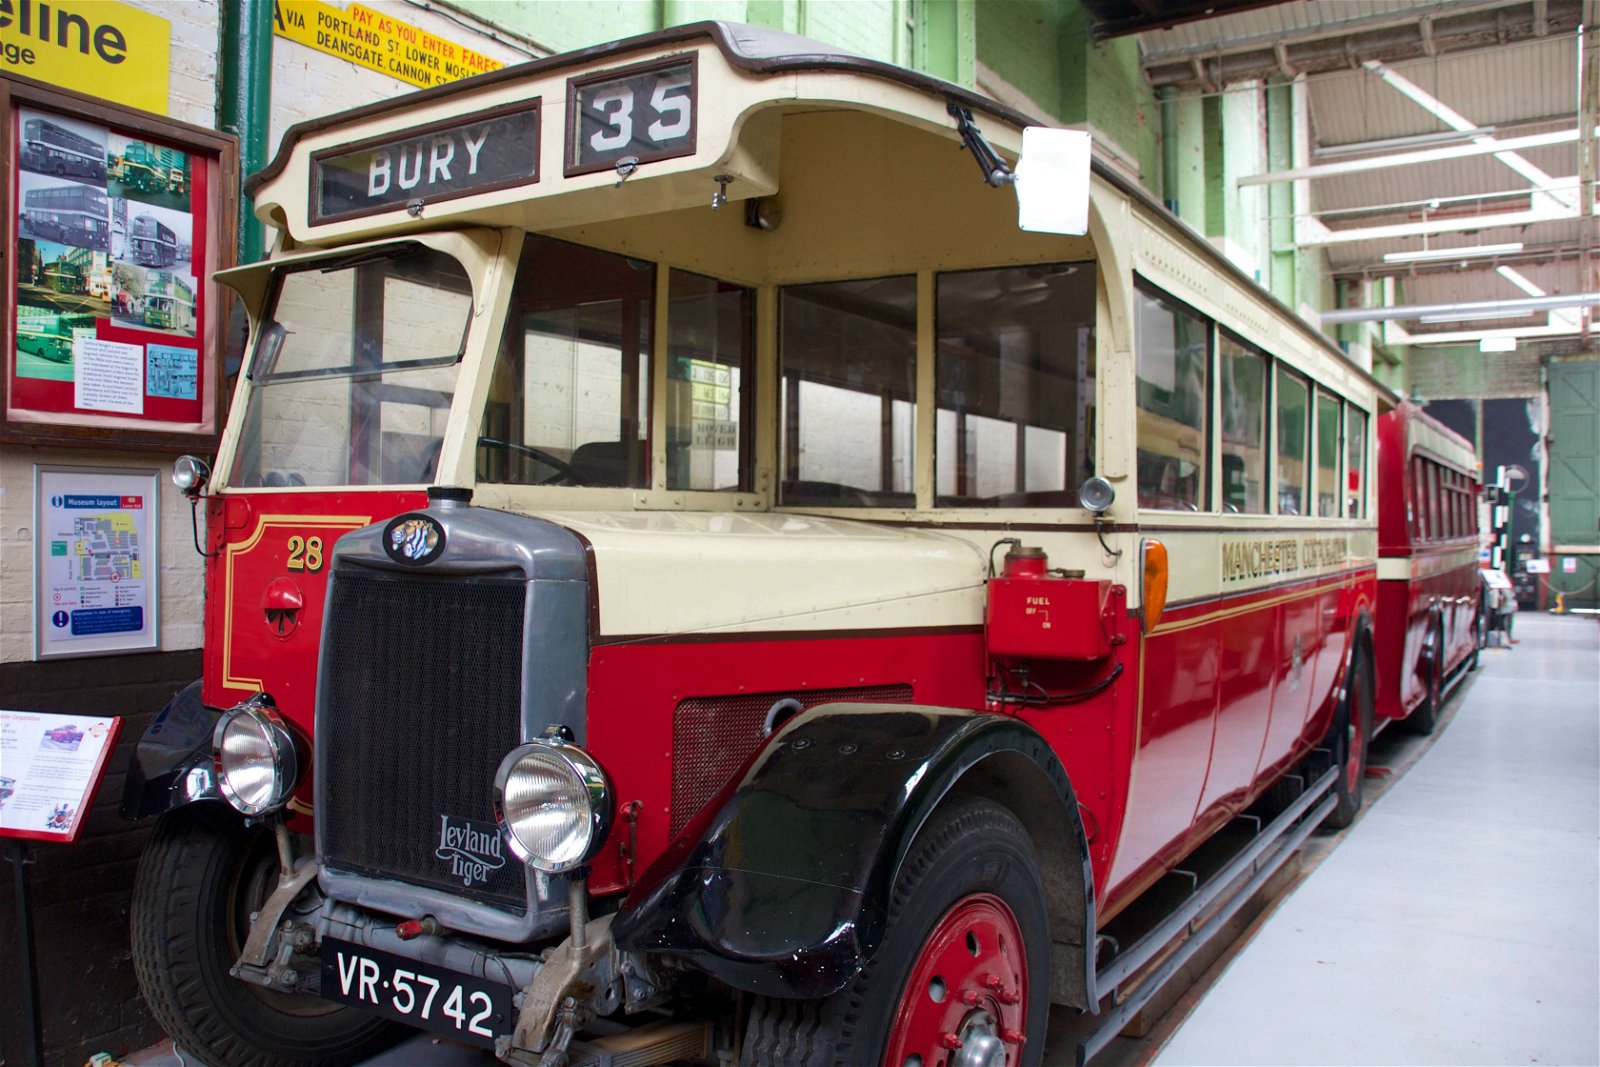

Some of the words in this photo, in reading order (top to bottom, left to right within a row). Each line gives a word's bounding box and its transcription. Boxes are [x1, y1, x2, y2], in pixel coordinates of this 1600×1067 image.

[0, 41, 36, 65] ge
[286, 8, 305, 30] VIA
[317, 11, 380, 46] PORTLAND
[406, 46, 440, 71] LOWER
[353, 7, 373, 26] PAY
[379, 18, 392, 34] AS
[396, 24, 416, 44] YOU
[422, 35, 454, 59] ENTER
[388, 58, 431, 86] CANNON
[590, 78, 692, 152] 35
[367, 125, 491, 198] BURY
[68, 498, 95, 506] Museum
[96, 498, 118, 508] Layout
[286, 535, 324, 573] 28
[1222, 540, 1298, 582] MANCHESTER
[1026, 597, 1050, 605] FUEL
[439, 814, 502, 858] Leyland
[451, 851, 491, 886] Tiger
